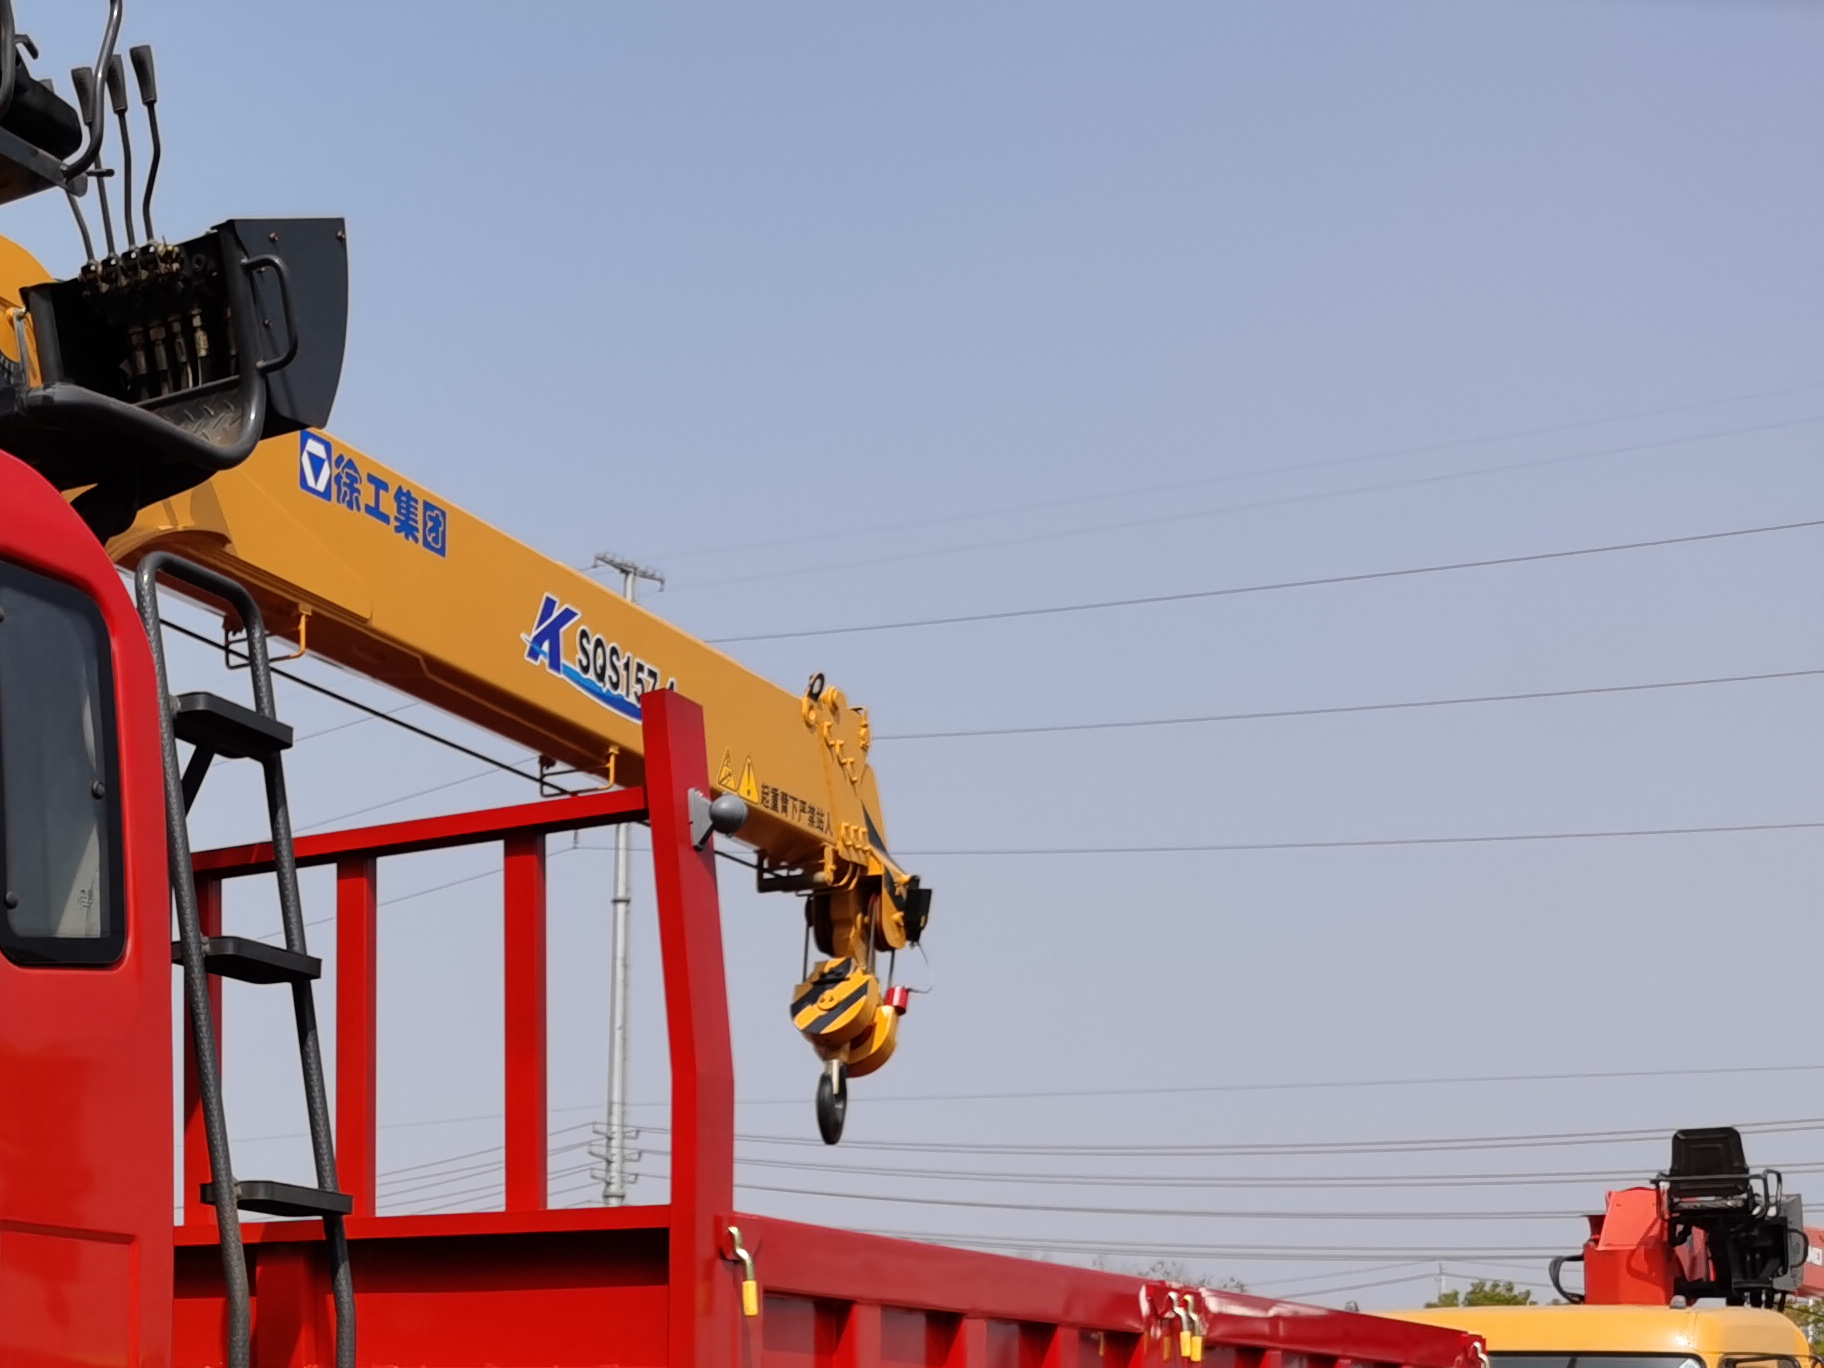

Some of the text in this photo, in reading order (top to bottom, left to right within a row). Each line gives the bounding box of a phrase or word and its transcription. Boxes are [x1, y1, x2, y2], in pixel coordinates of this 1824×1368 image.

[334, 453, 446, 558] 徐工集团
[577, 628, 676, 703] SQS157
